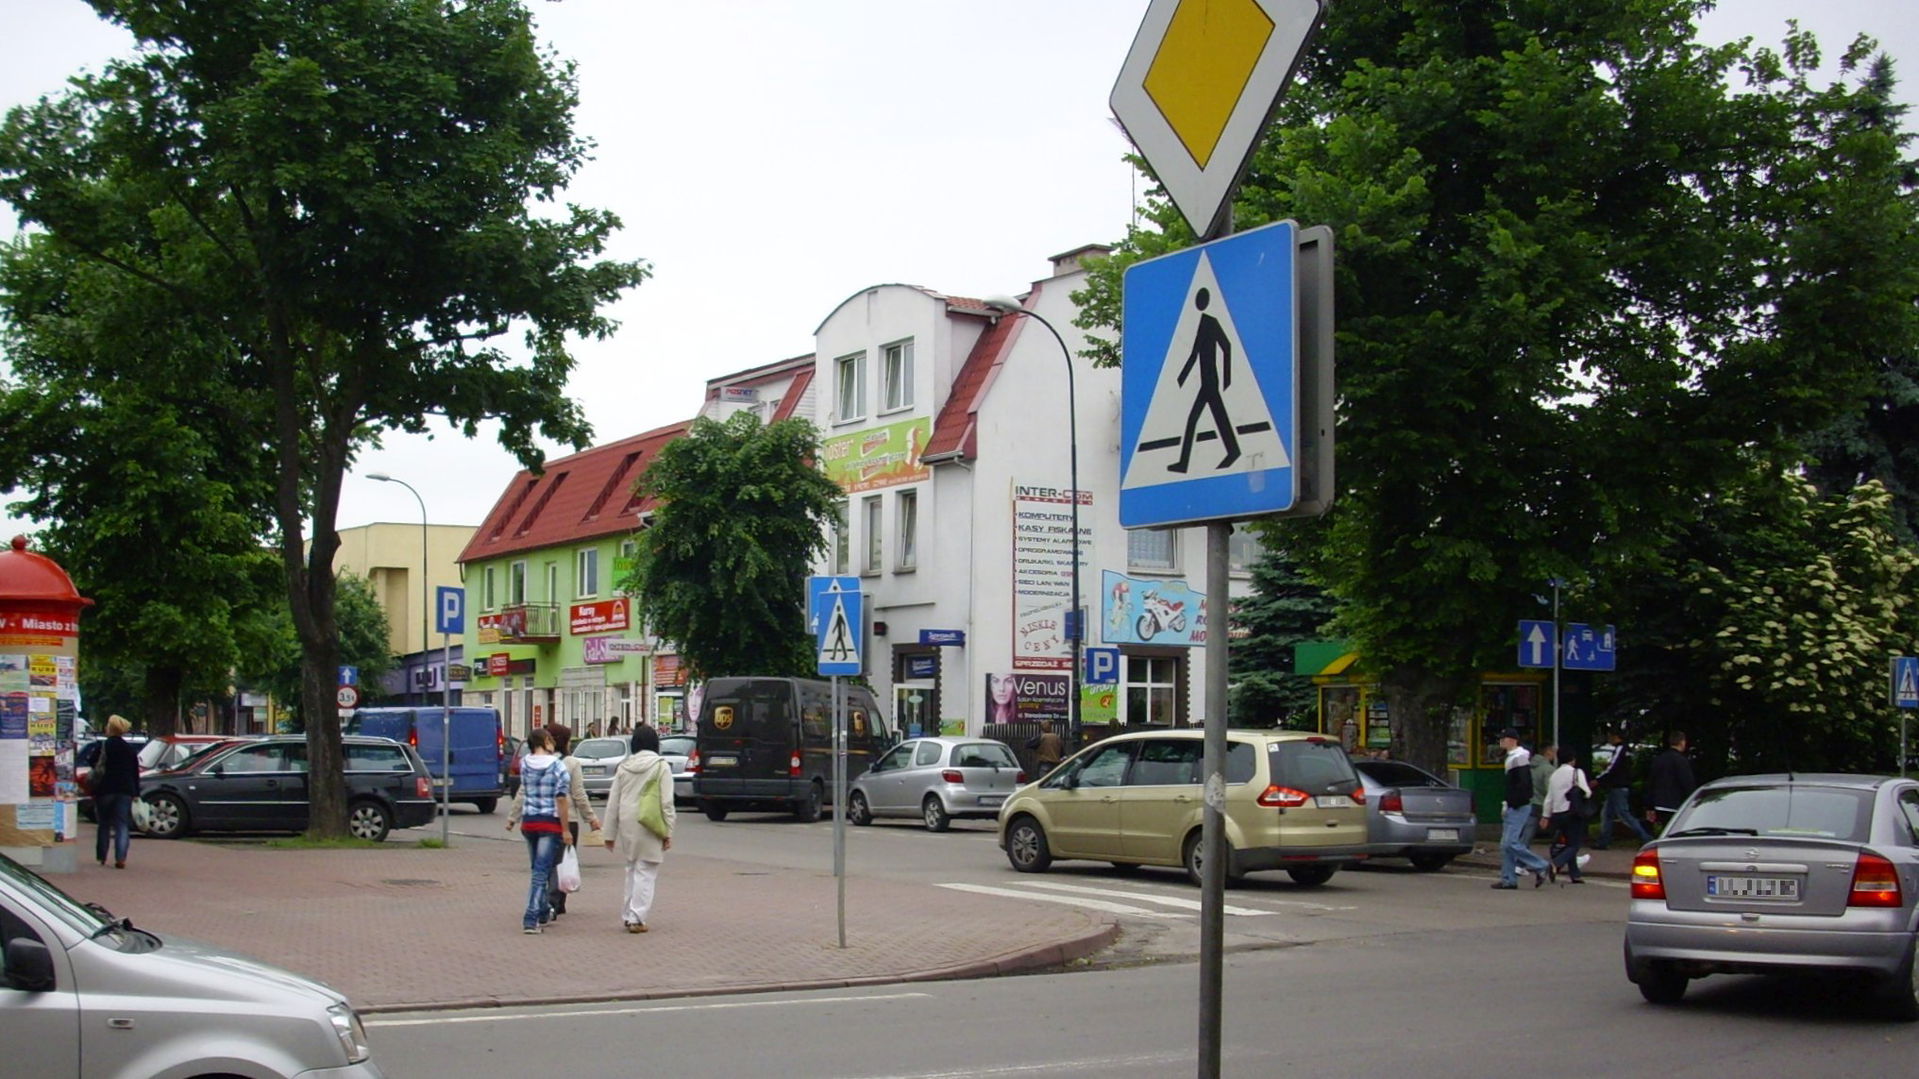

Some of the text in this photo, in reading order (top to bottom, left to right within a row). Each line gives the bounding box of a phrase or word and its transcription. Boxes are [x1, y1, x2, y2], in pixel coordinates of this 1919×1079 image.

[1018, 525, 1093, 536] KASY FISKANE
[1018, 536, 1093, 546] SYSTEMY ALAROWE
[1018, 589, 1071, 597] MODERNIZACJA
[22, 618, 63, 631] Miasto
[1024, 635, 1060, 652] CENY
[1093, 651, 1113, 680] P
[1012, 678, 1066, 696] Venus
